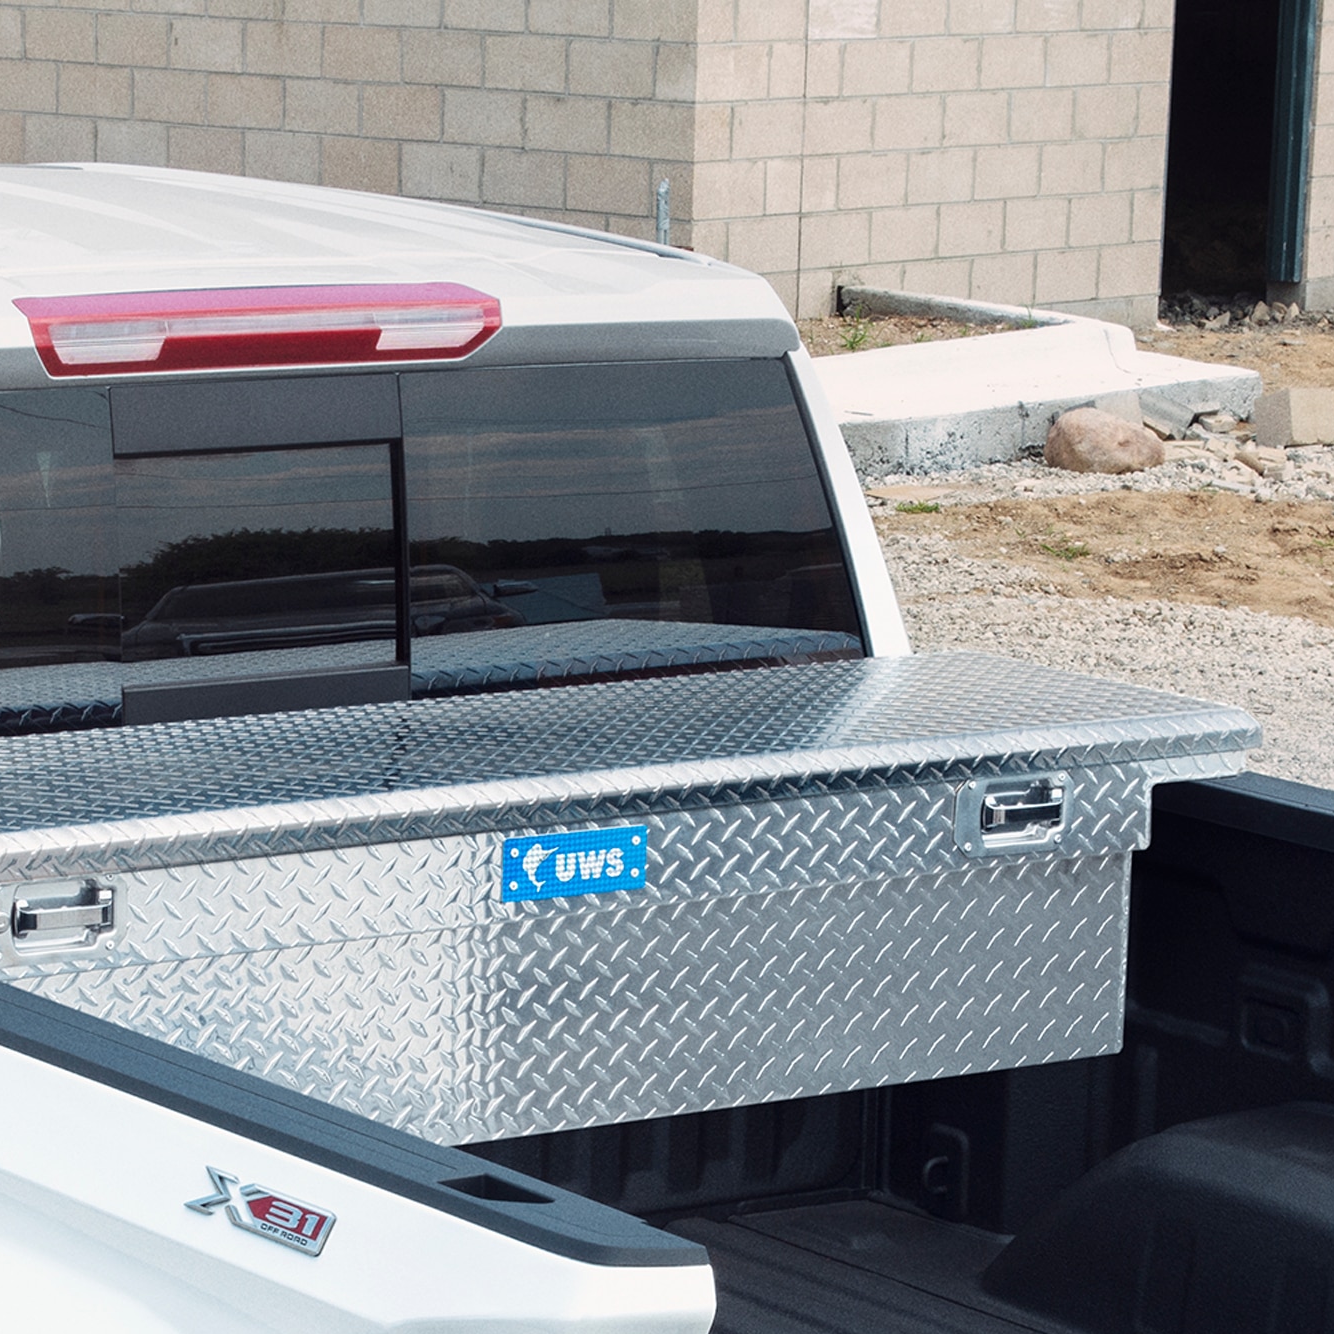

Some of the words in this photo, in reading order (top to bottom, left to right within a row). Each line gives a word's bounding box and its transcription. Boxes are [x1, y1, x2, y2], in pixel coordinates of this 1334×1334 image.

[555, 848, 624, 882] UWS
[183, 1165, 329, 1243] X31
[260, 1222, 280, 1235] OFF
[280, 1230, 308, 1247] ROAD
